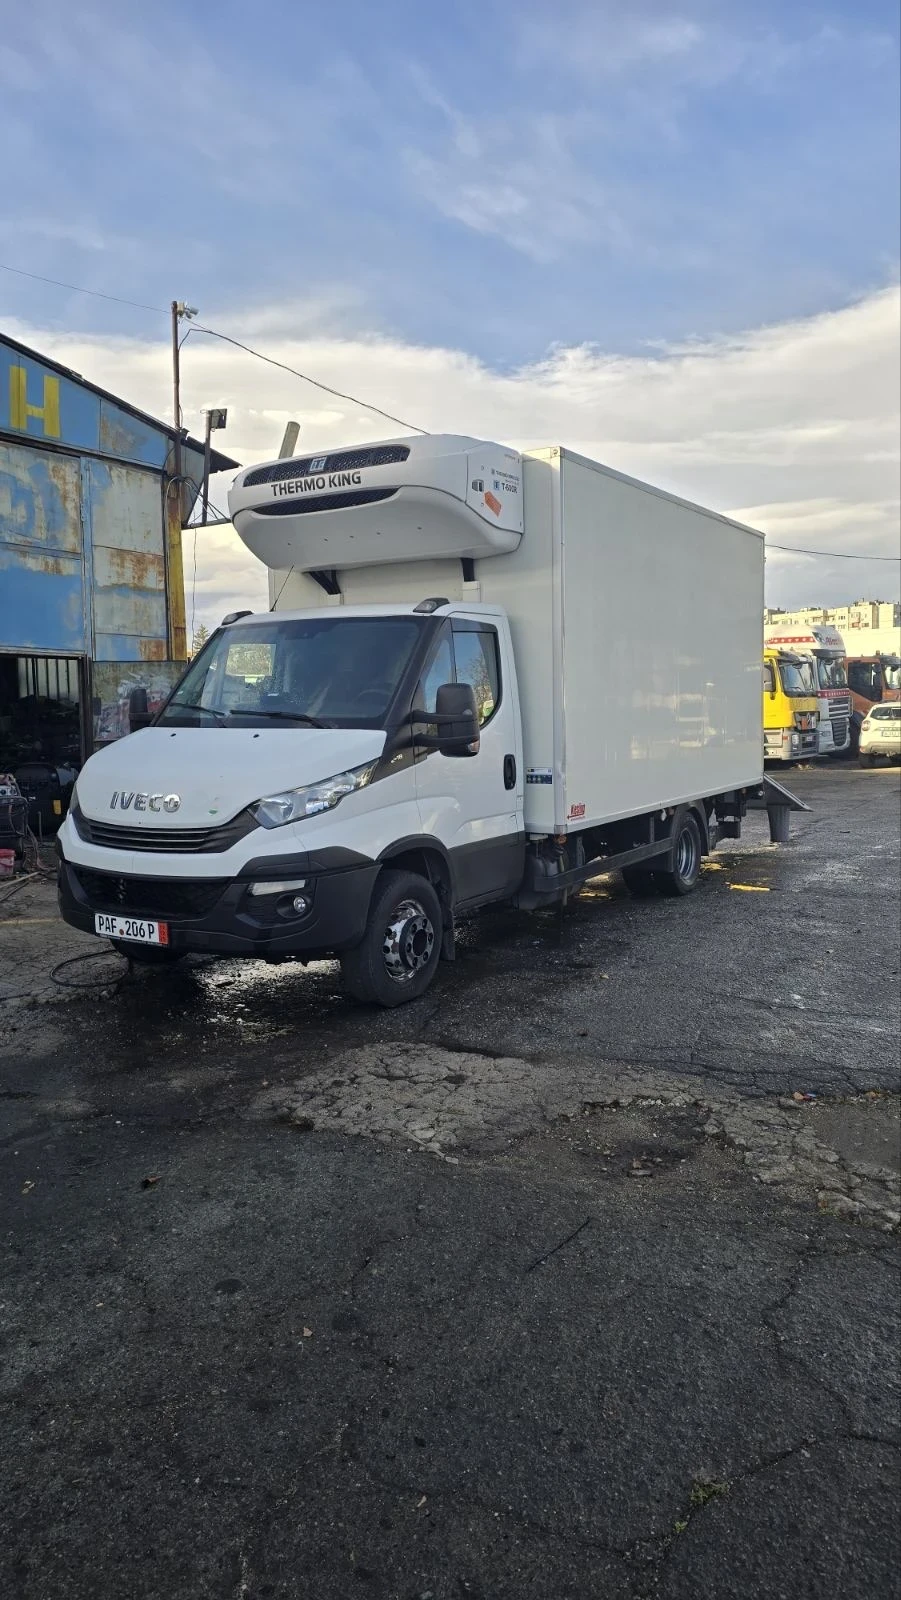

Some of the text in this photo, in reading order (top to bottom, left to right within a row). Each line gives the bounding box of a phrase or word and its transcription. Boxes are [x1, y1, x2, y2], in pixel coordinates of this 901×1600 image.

[271, 471, 362, 496] THERMO KING
[110, 791, 181, 813] IVECO
[98, 915, 117, 933] PAF
[125, 920, 146, 938] 206
[148, 923, 155, 939] P
